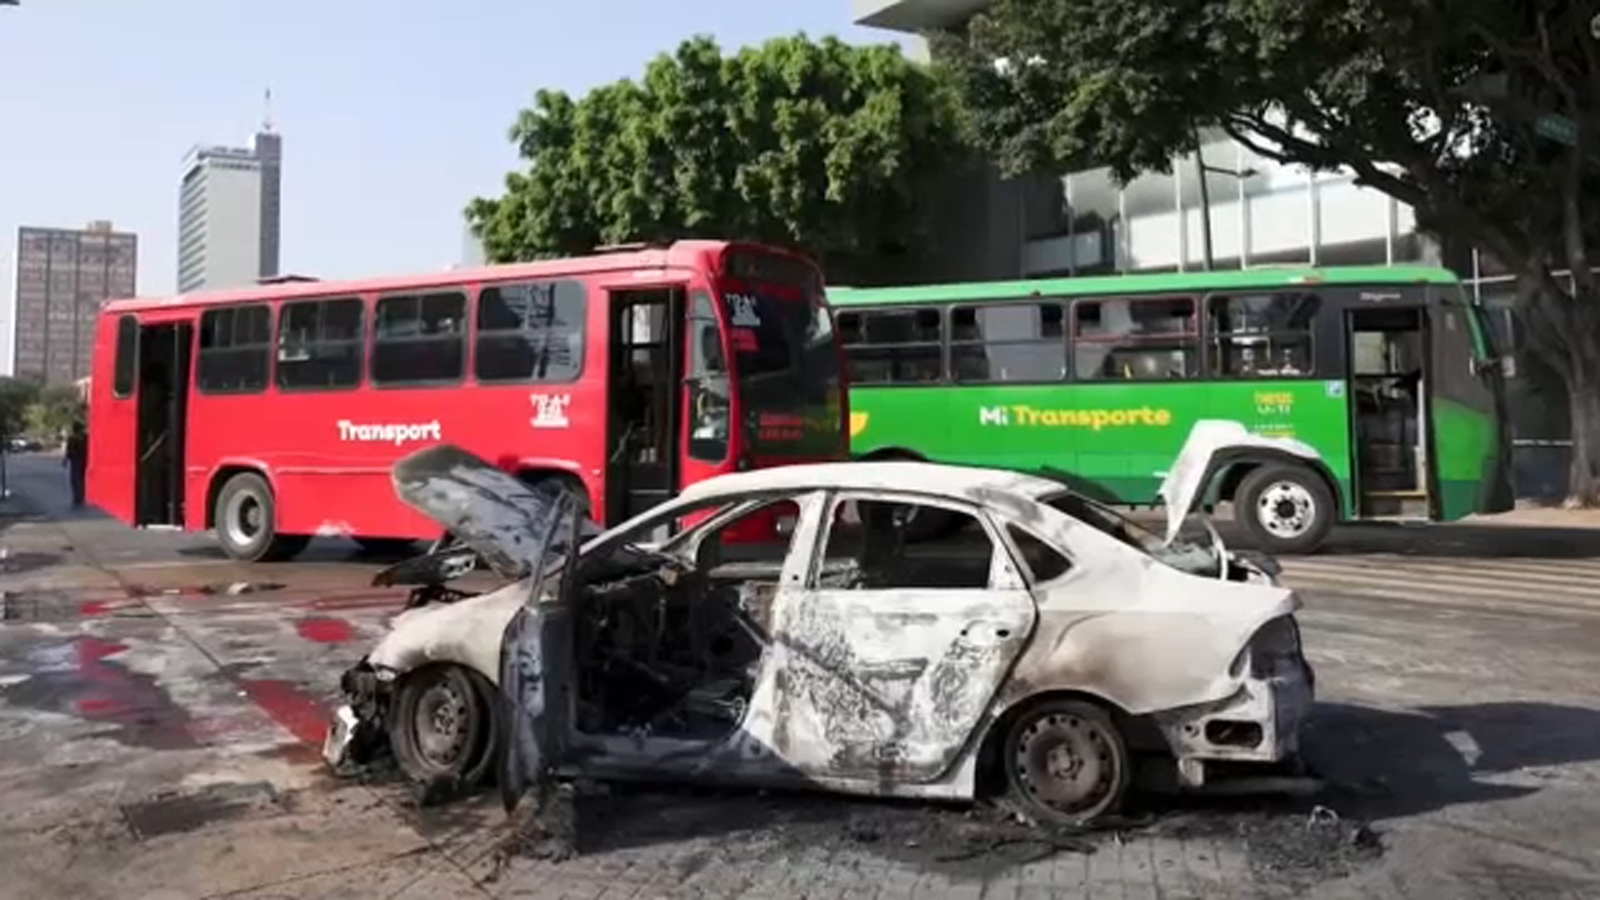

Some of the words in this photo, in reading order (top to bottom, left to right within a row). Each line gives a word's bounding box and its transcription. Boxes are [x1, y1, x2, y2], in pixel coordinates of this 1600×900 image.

[979, 405, 1009, 426] Mi
[1012, 405, 1171, 431] Transporte
[337, 419, 441, 447] Transport
